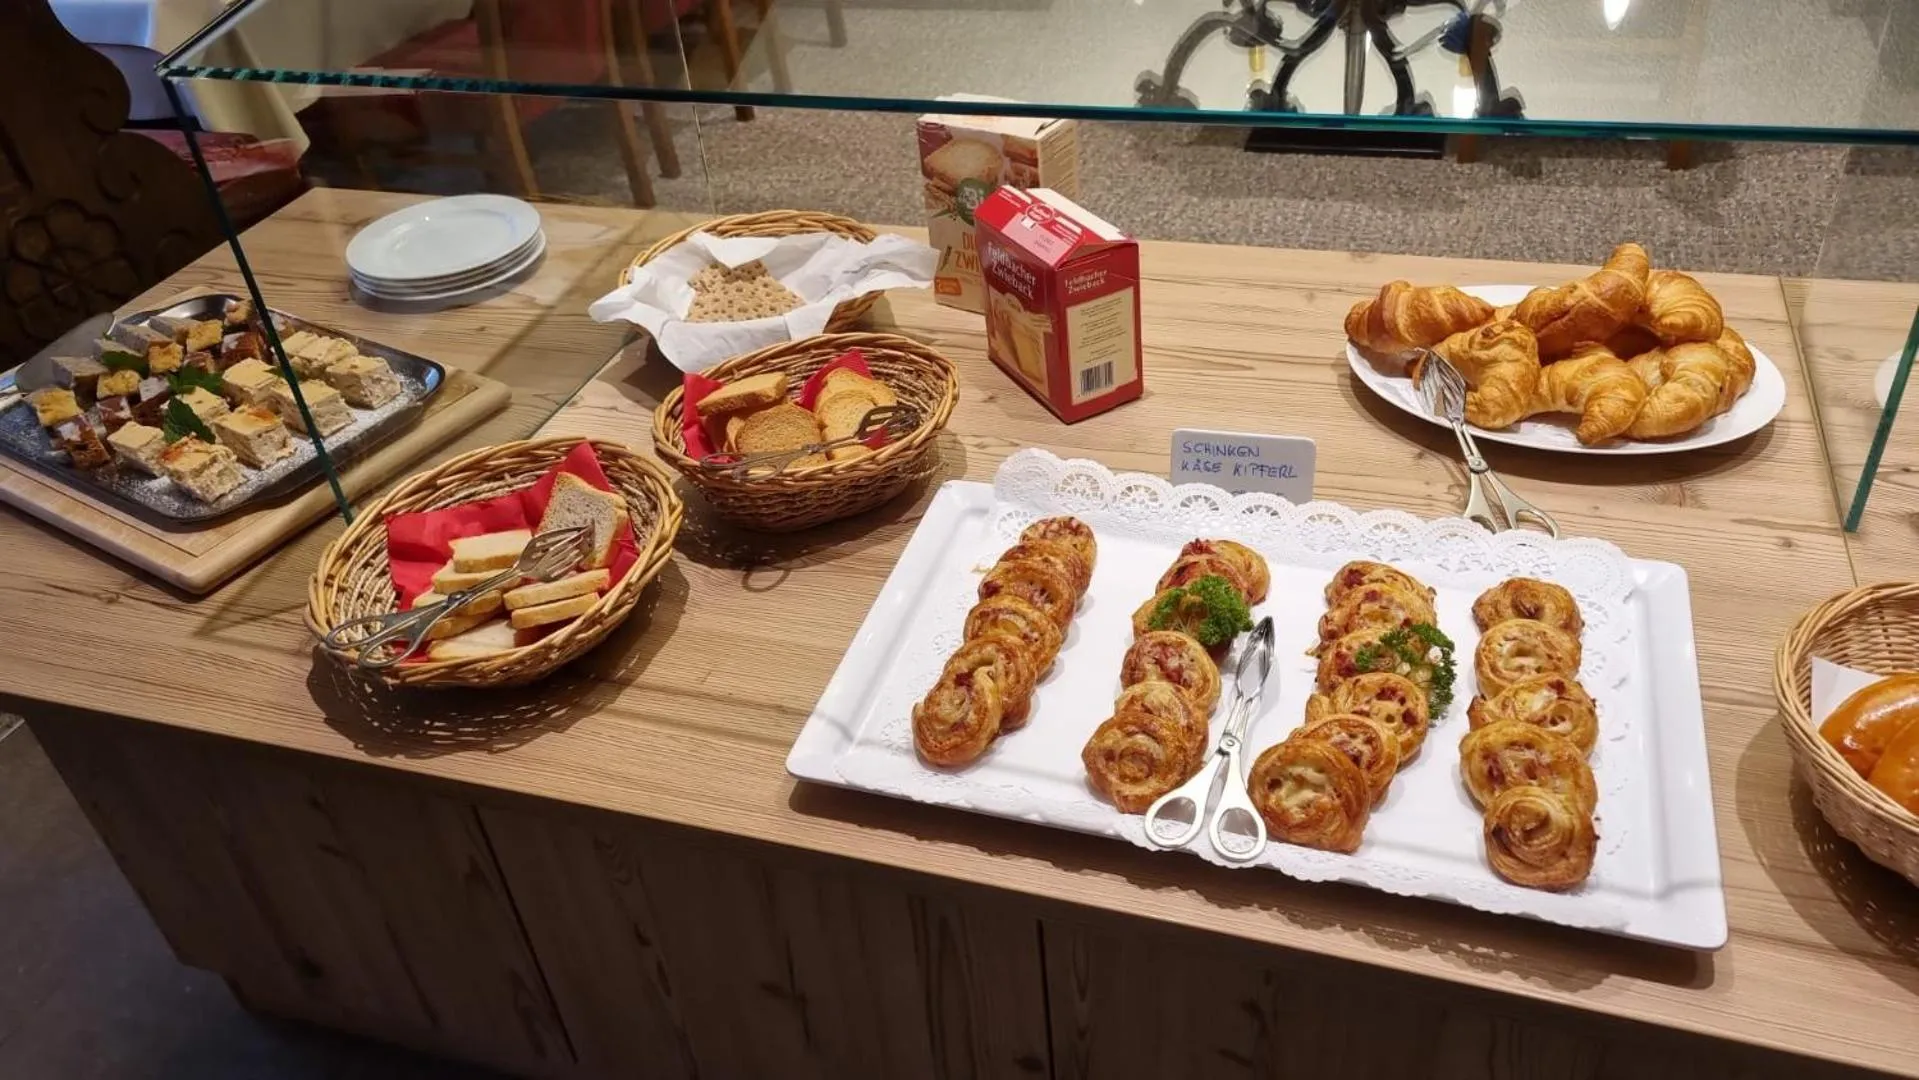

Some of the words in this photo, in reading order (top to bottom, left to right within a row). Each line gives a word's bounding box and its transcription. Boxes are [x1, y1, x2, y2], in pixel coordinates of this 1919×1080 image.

[992, 260, 1033, 299] Zwieback
[1182, 441, 1260, 457] SCHINKEN
[1180, 459, 1222, 473] KÄSE
[1233, 463, 1298, 478] KIPFERL
